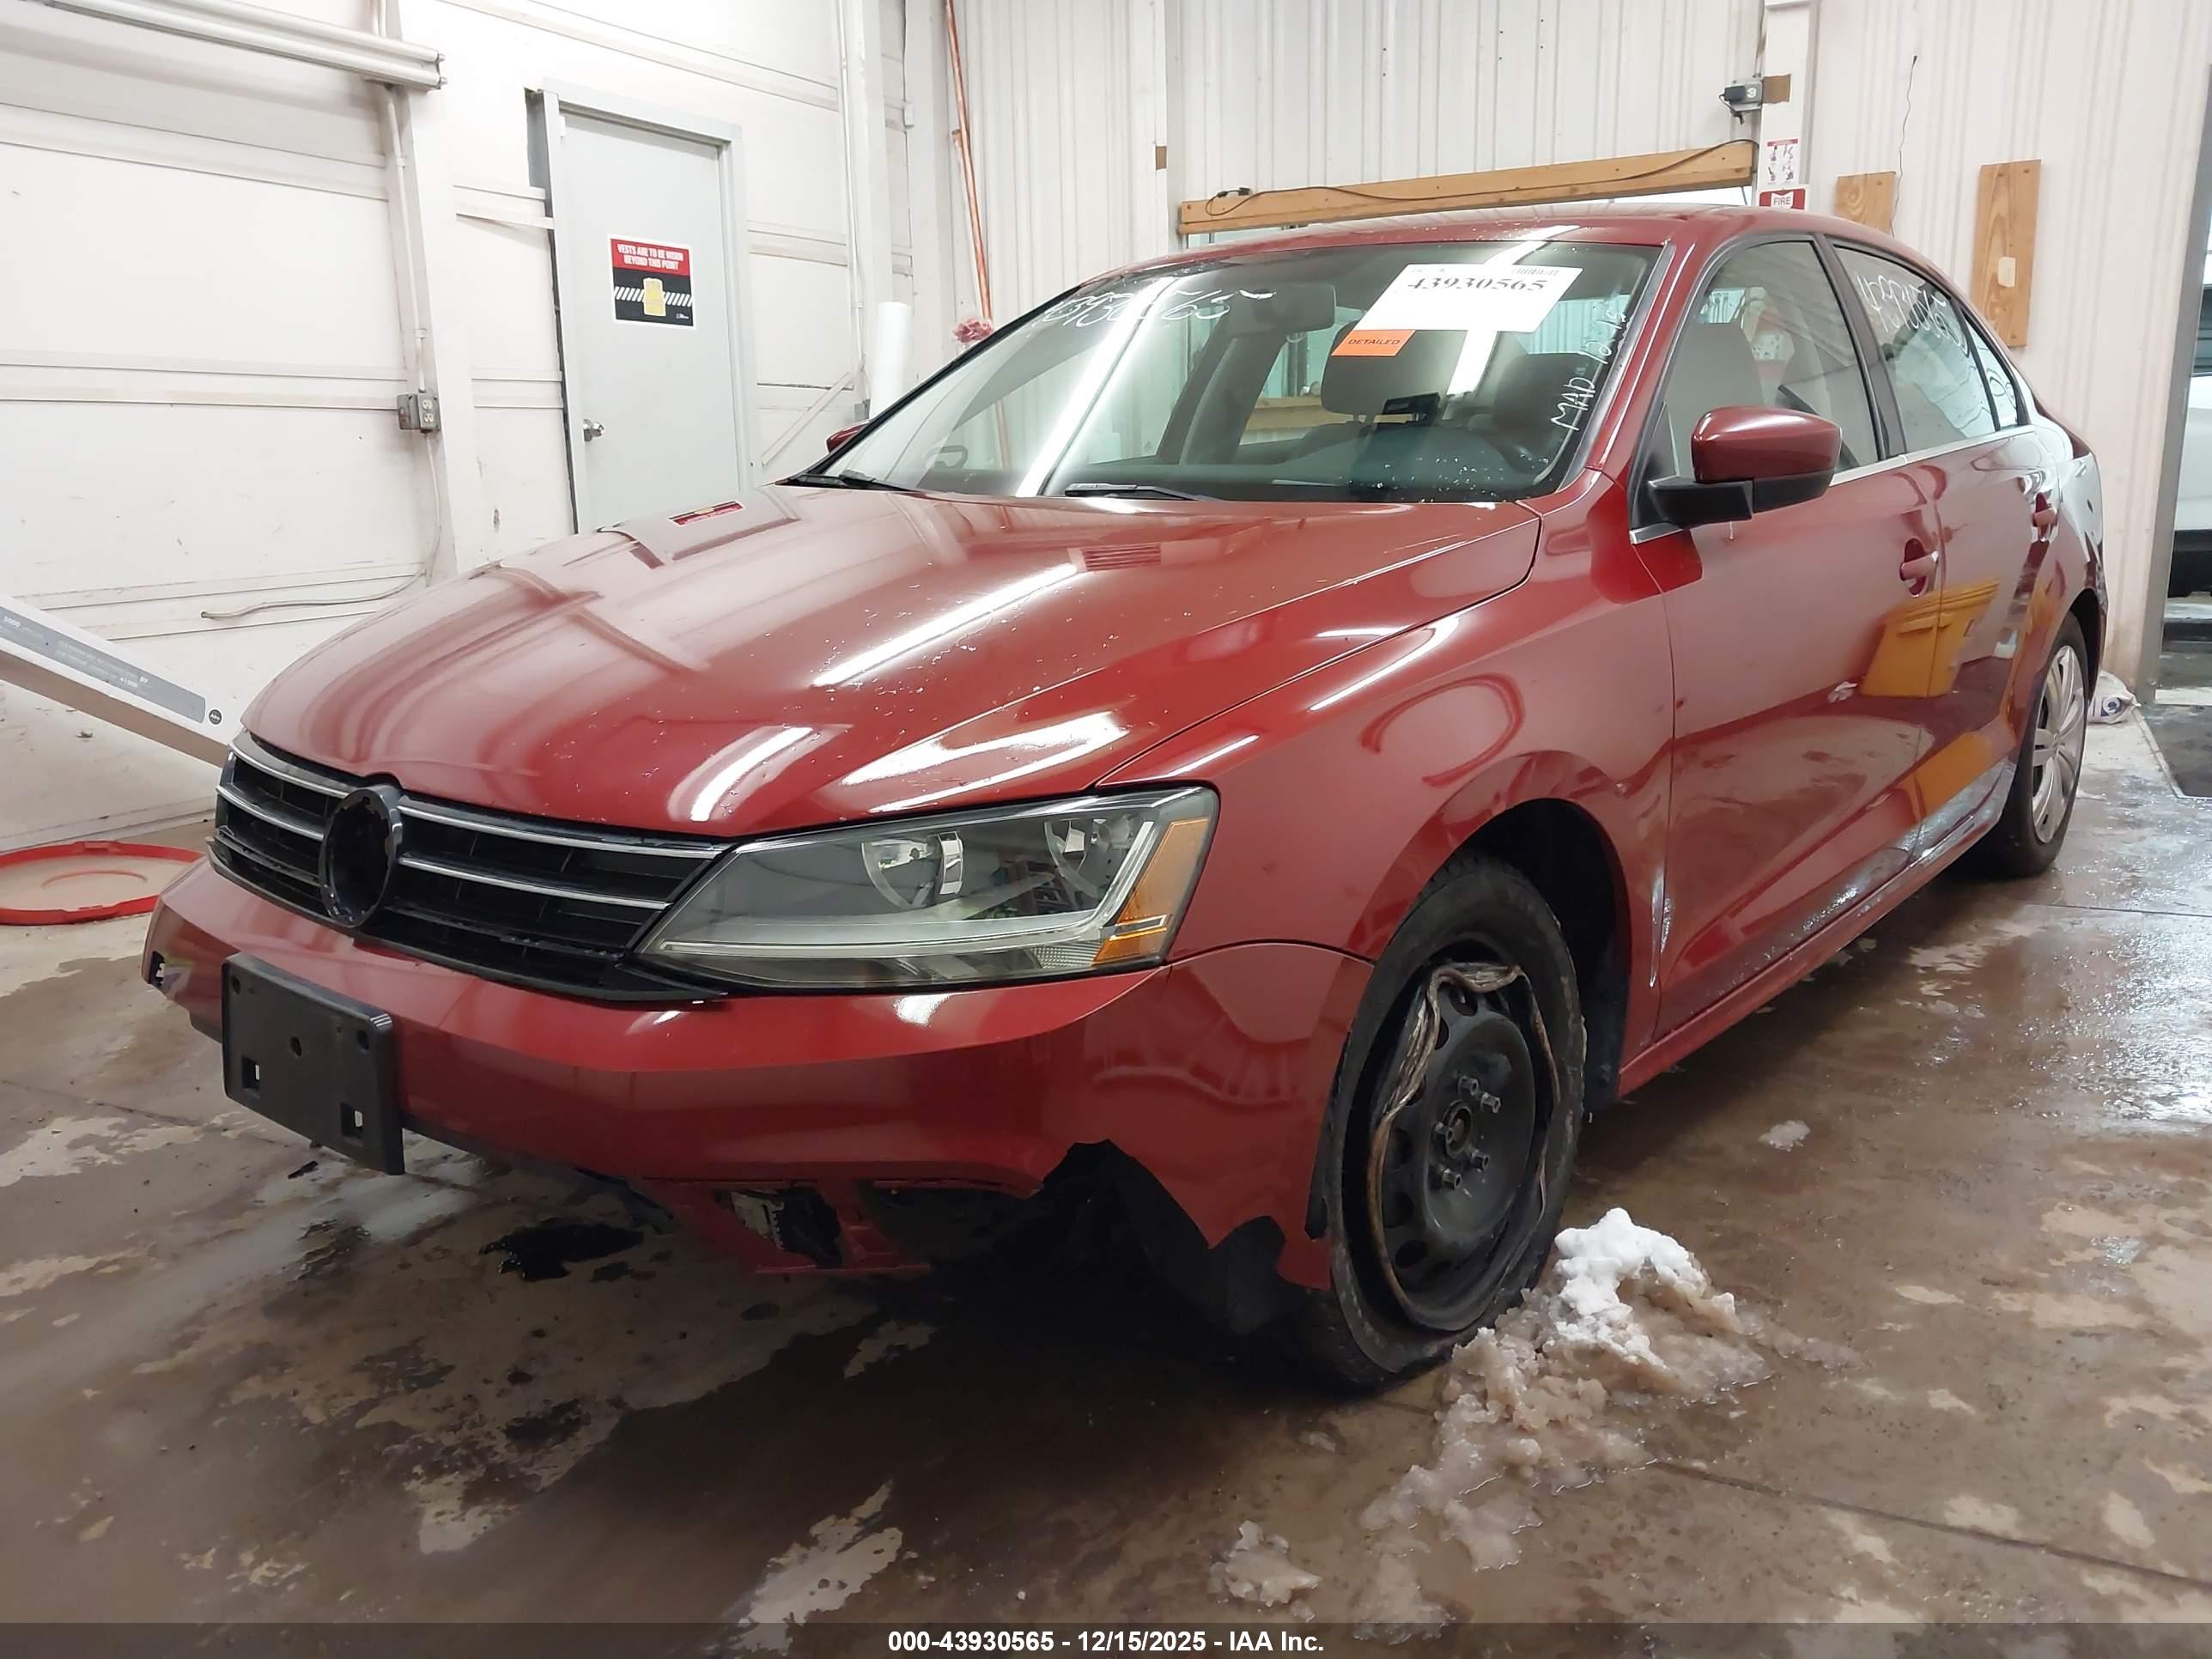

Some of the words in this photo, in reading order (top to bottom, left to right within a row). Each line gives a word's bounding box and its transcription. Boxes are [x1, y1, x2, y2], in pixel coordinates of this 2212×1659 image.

[1772, 197, 1791, 206] FIRE
[617, 243, 636, 255] VESTS
[637, 246, 648, 257] ARE
[649, 247, 657, 258] TO
[1407, 277, 1548, 292] 43930565
